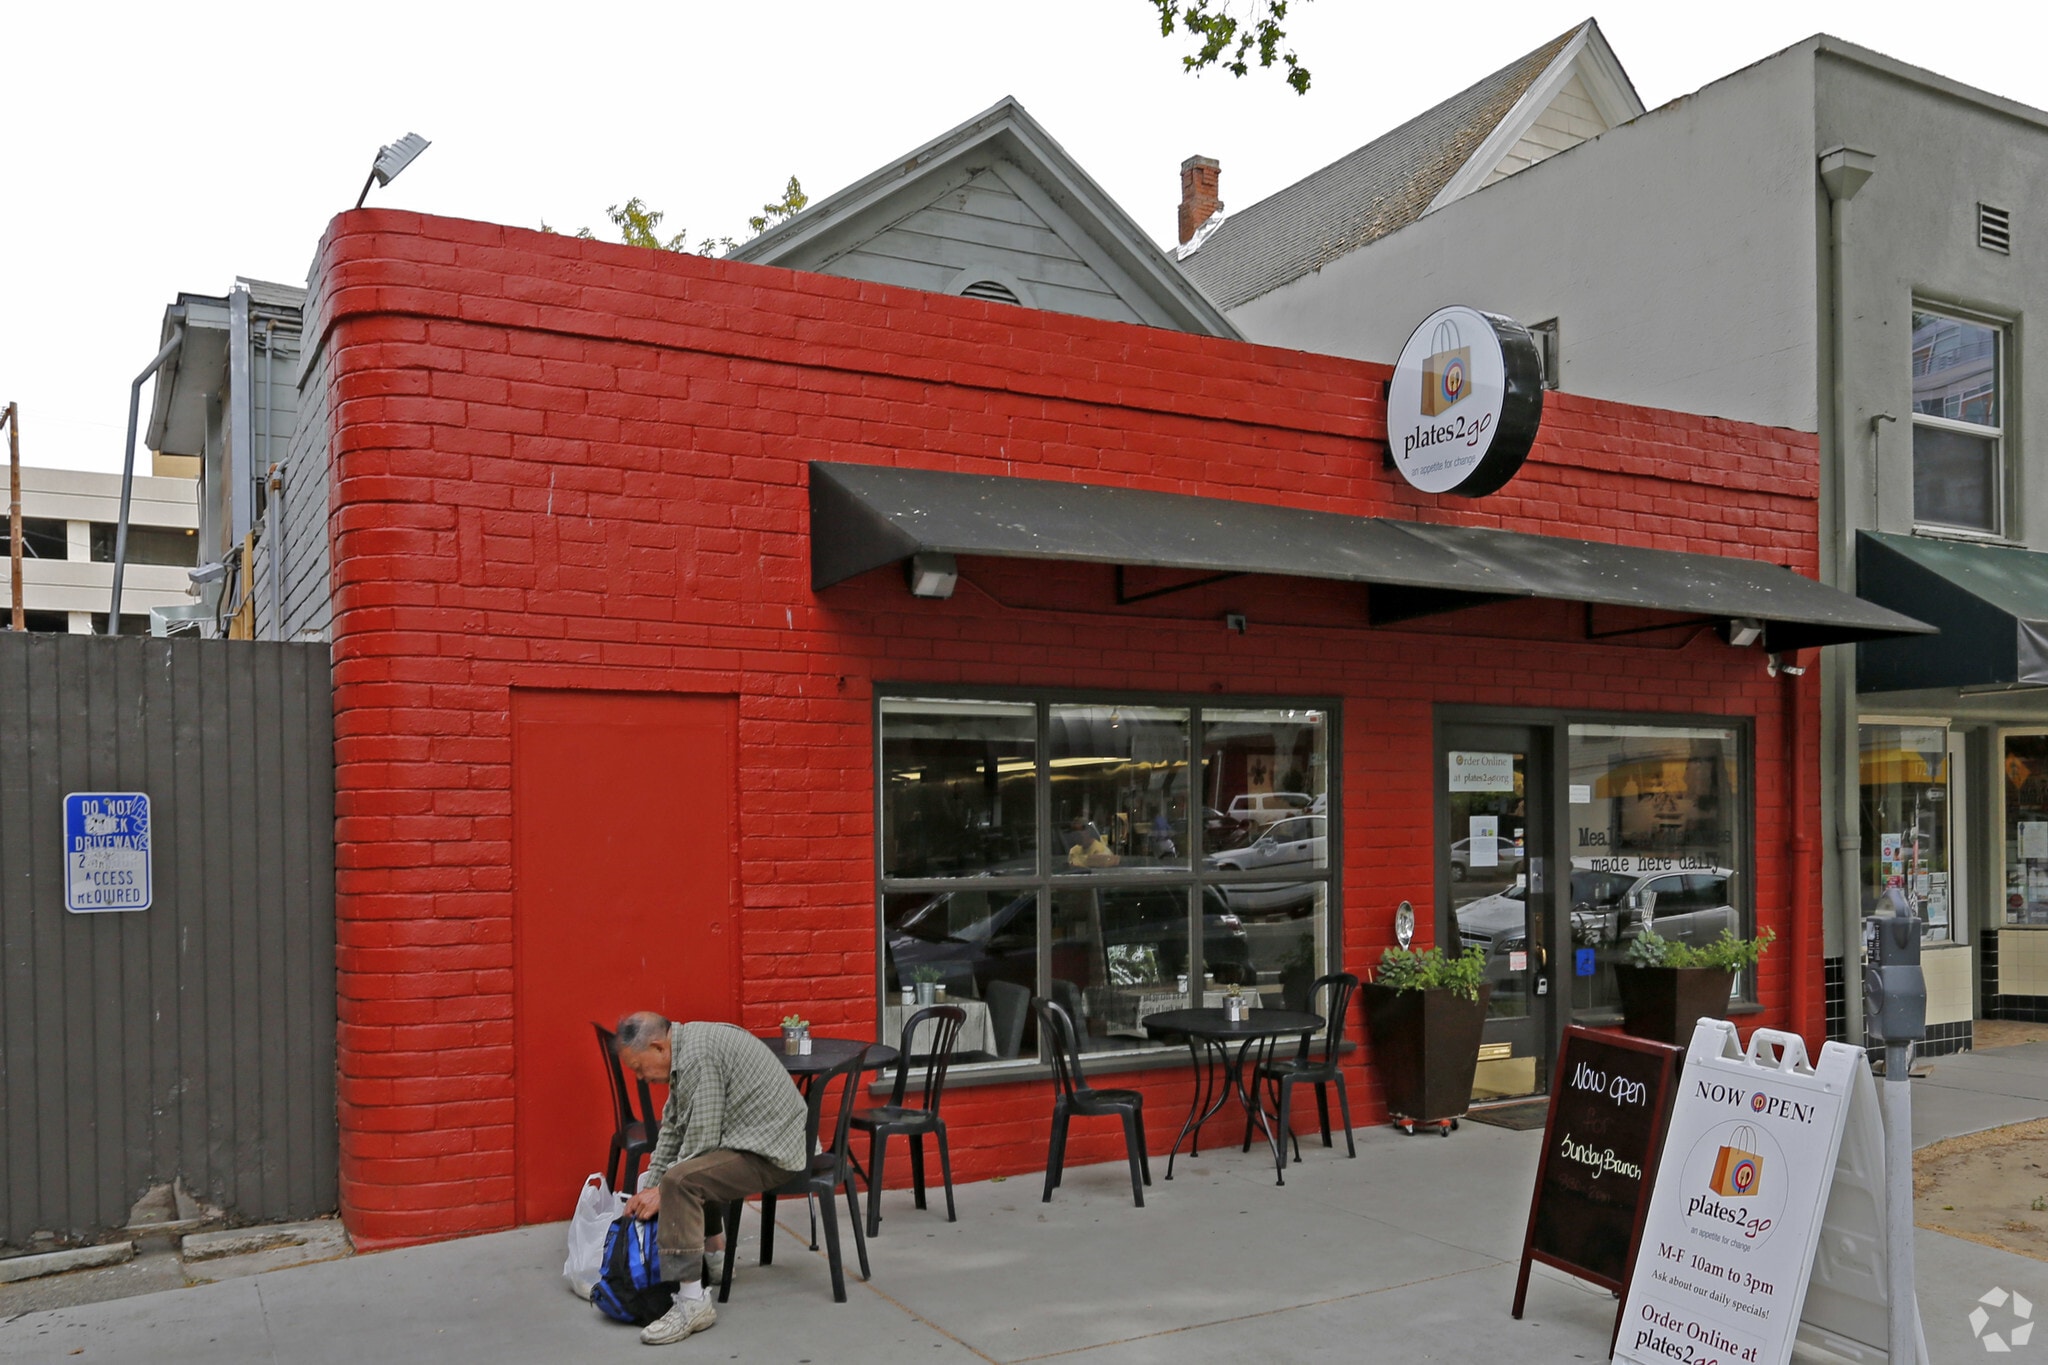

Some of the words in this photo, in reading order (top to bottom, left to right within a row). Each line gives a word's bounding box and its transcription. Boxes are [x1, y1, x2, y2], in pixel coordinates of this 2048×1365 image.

[1404, 412, 1492, 460] plates2go
[1411, 468, 1419, 476] an
[1420, 461, 1444, 476] appetite
[1445, 458, 1453, 469] for
[1454, 454, 1477, 467] change
[1456, 754, 1480, 766] Order
[1481, 756, 1507, 767] Online
[1454, 774, 1461, 782] at
[82, 800, 99, 816] DO
[107, 800, 132, 816] NOT
[75, 835, 140, 852] DRIVEWAY
[1591, 855, 1630, 873] made
[1637, 852, 1672, 872] here
[1679, 850, 1721, 874] daily
[86, 871, 134, 886] ACCESS
[78, 888, 140, 904] REQUIRED
[1571, 1061, 1607, 1093] Now
[1609, 1075, 1646, 1107] open
[1695, 1080, 1745, 1107] NOW
[1750, 1091, 1815, 1124] OPEN!
[1561, 1133, 1603, 1179] Sunday
[1603, 1149, 1642, 1181] Brunch
[1687, 1195, 1772, 1238] plates2go
[1691, 1226, 1699, 1234] an
[1699, 1227, 1721, 1242] appetite
[1721, 1236, 1729, 1245] for
[1730, 1239, 1751, 1253] change
[1657, 1242, 1686, 1264] M-F
[1690, 1254, 1724, 1278] 10am
[1727, 1267, 1741, 1283] to
[1743, 1273, 1774, 1296] 3pm
[1651, 1269, 1667, 1282] Ask
[1668, 1276, 1692, 1292] about
[1693, 1286, 1709, 1298] our
[1709, 1290, 1731, 1308] daily
[1732, 1299, 1770, 1320] specials!
[1641, 1304, 1684, 1334] Order
[1686, 1321, 1739, 1356] Online
[1741, 1347, 1758, 1363] at
